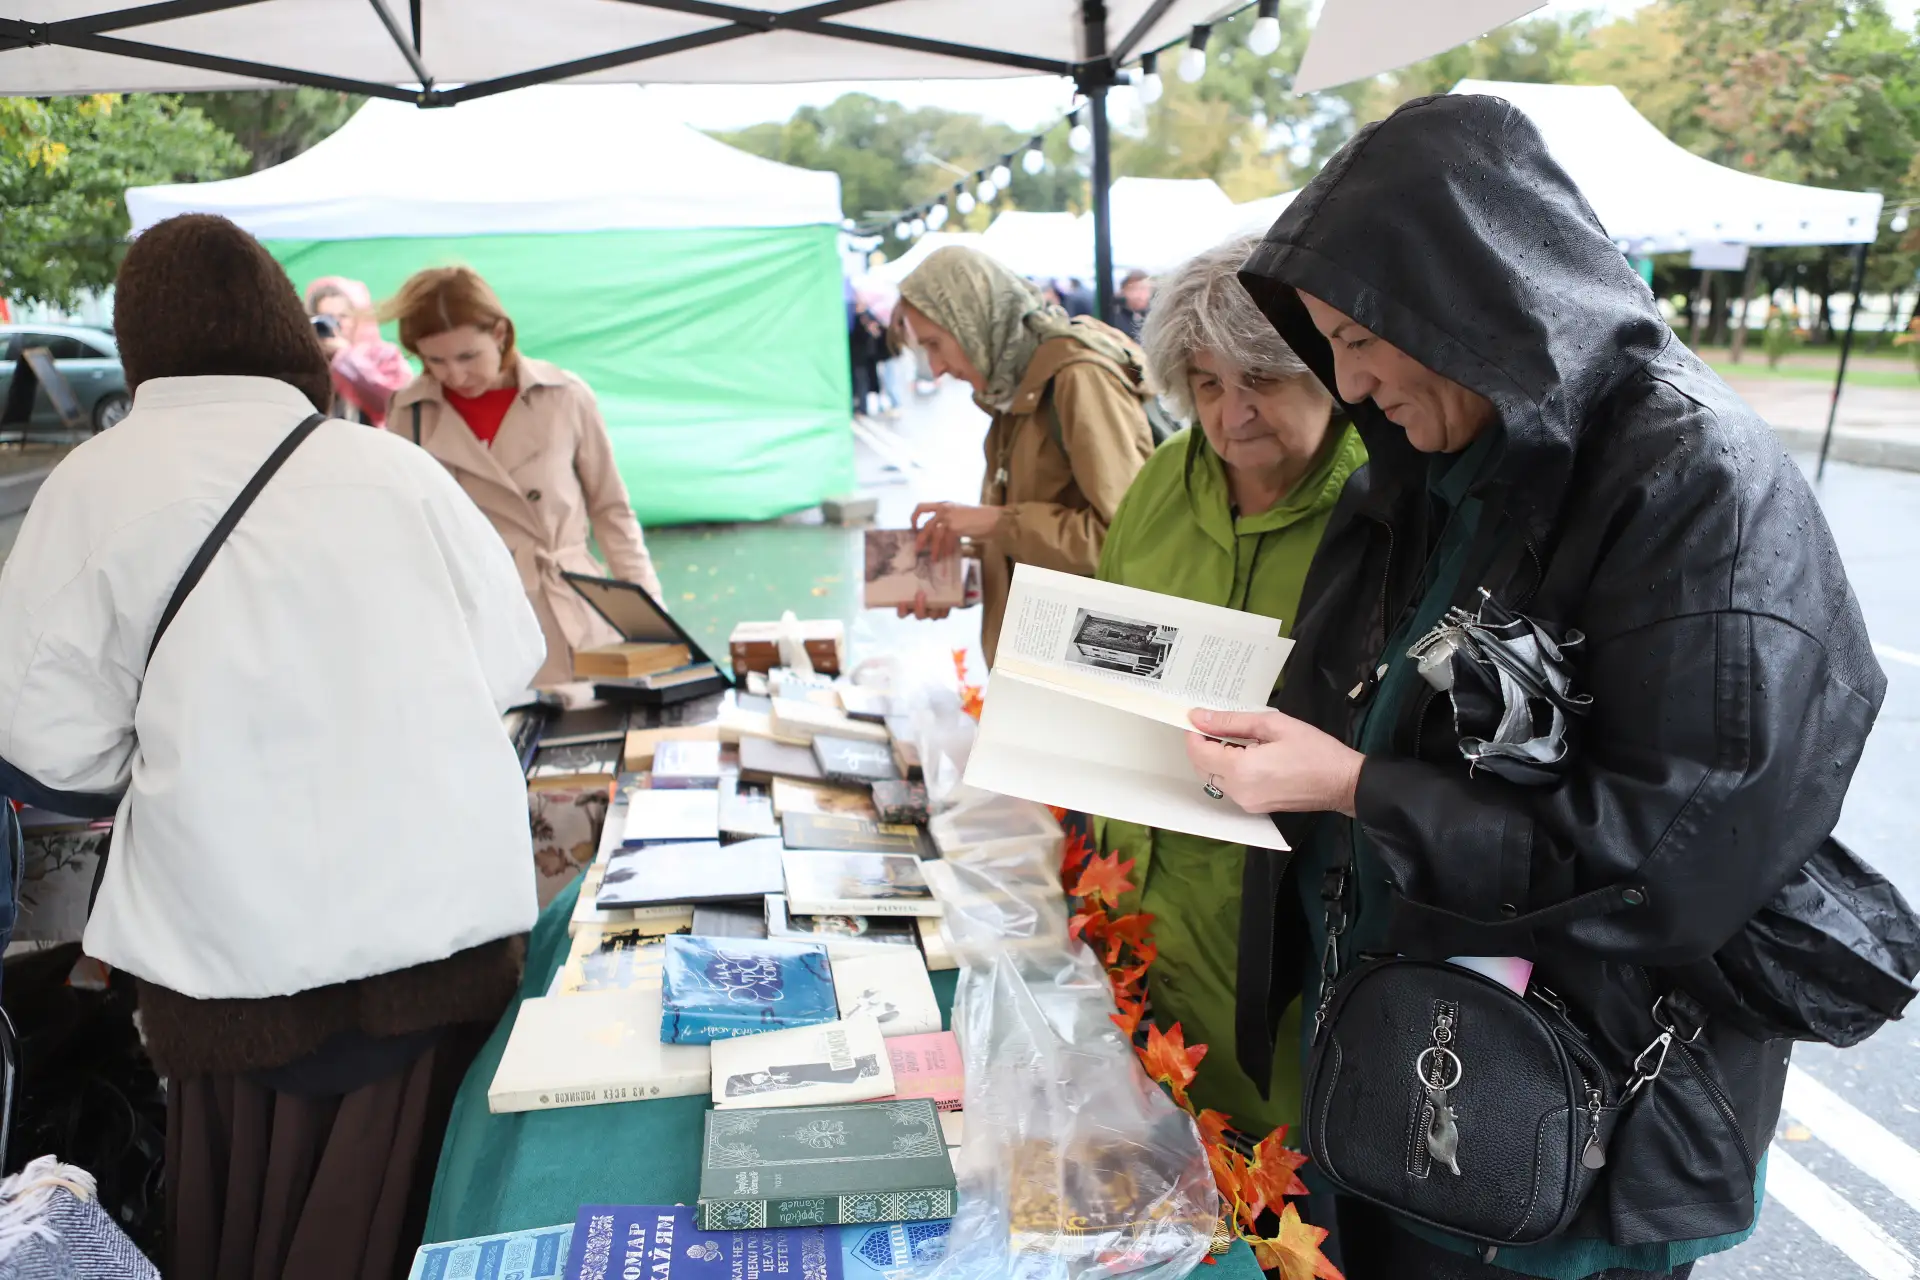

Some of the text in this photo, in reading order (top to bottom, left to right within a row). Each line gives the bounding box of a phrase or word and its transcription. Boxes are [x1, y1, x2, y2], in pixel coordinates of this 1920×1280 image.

[603, 1088, 626, 1099] ВСЕХ
[632, 1087, 645, 1097] ИЗ
[622, 1223, 646, 1280] ОМАР
[748, 1251, 760, 1280] ЩЕКИ
